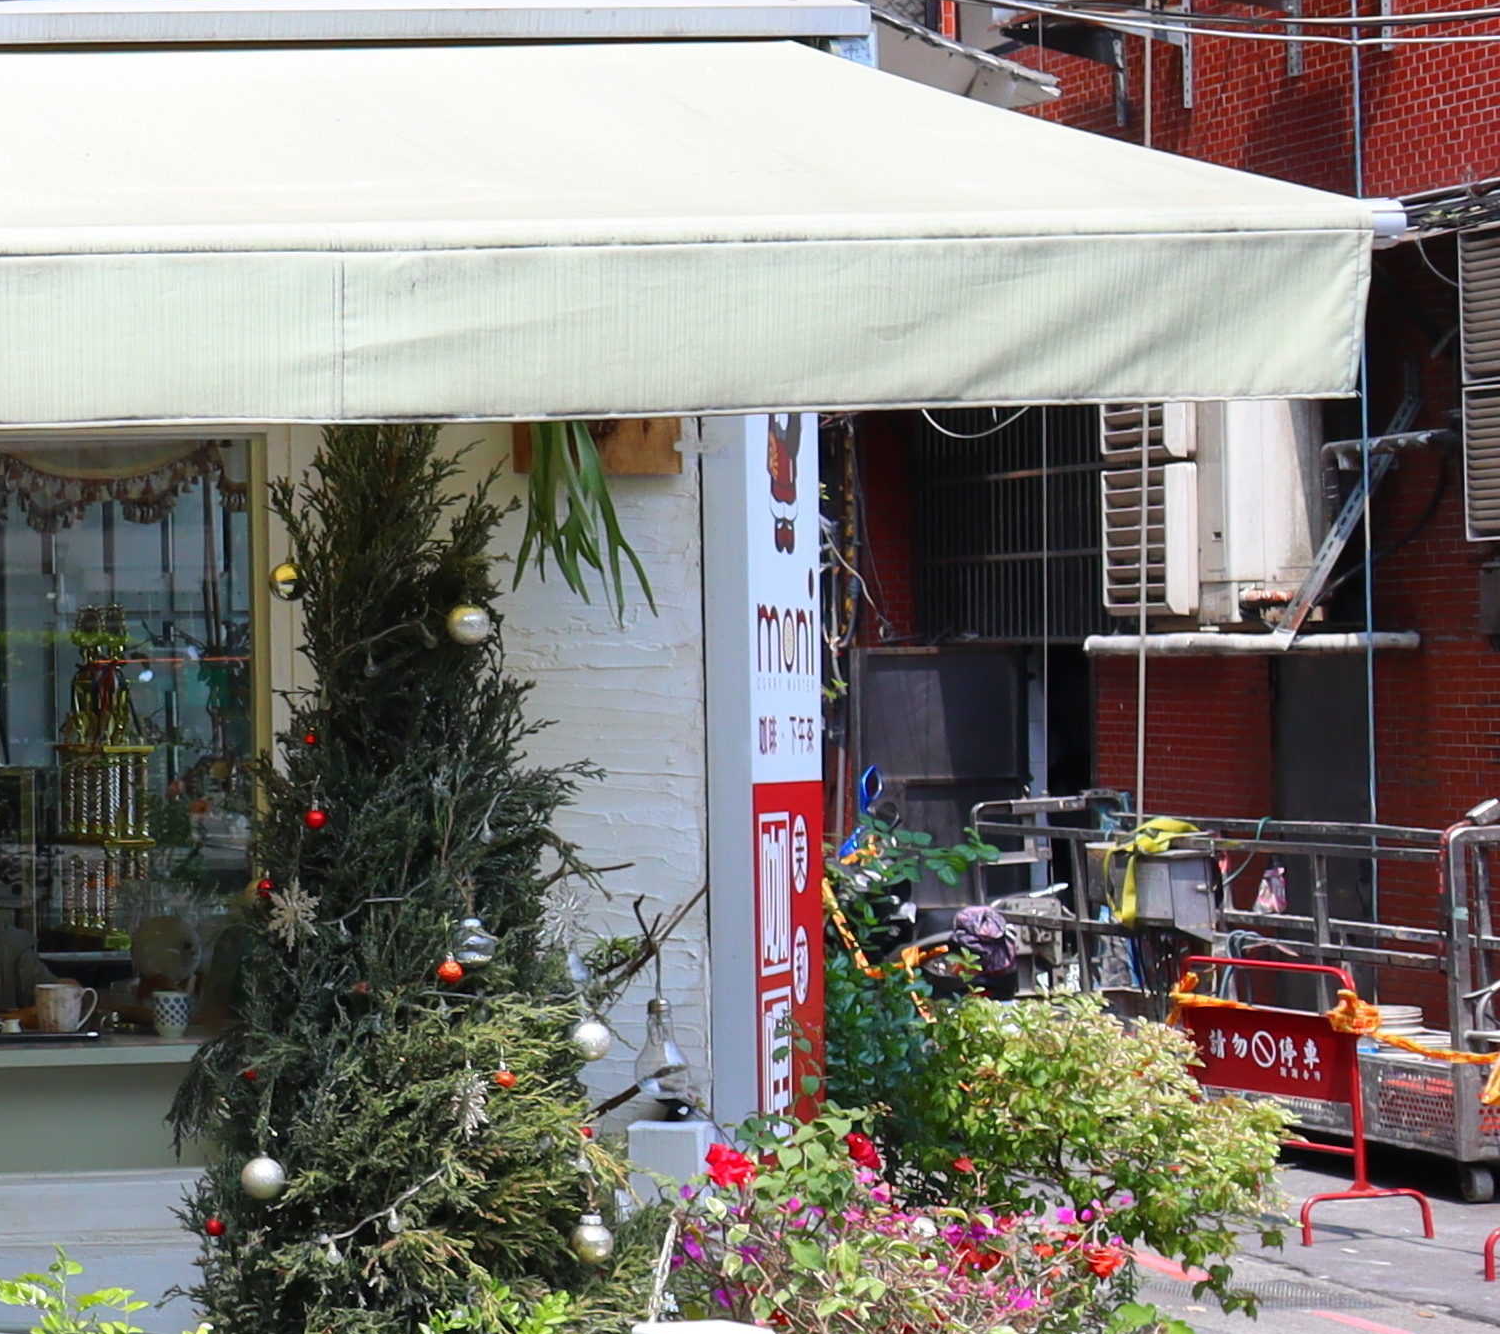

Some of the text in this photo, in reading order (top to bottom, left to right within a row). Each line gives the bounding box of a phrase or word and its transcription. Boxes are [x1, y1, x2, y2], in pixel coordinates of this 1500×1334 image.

[756, 568, 815, 677] moni
[1208, 1028, 1321, 1070] 請勿停車
